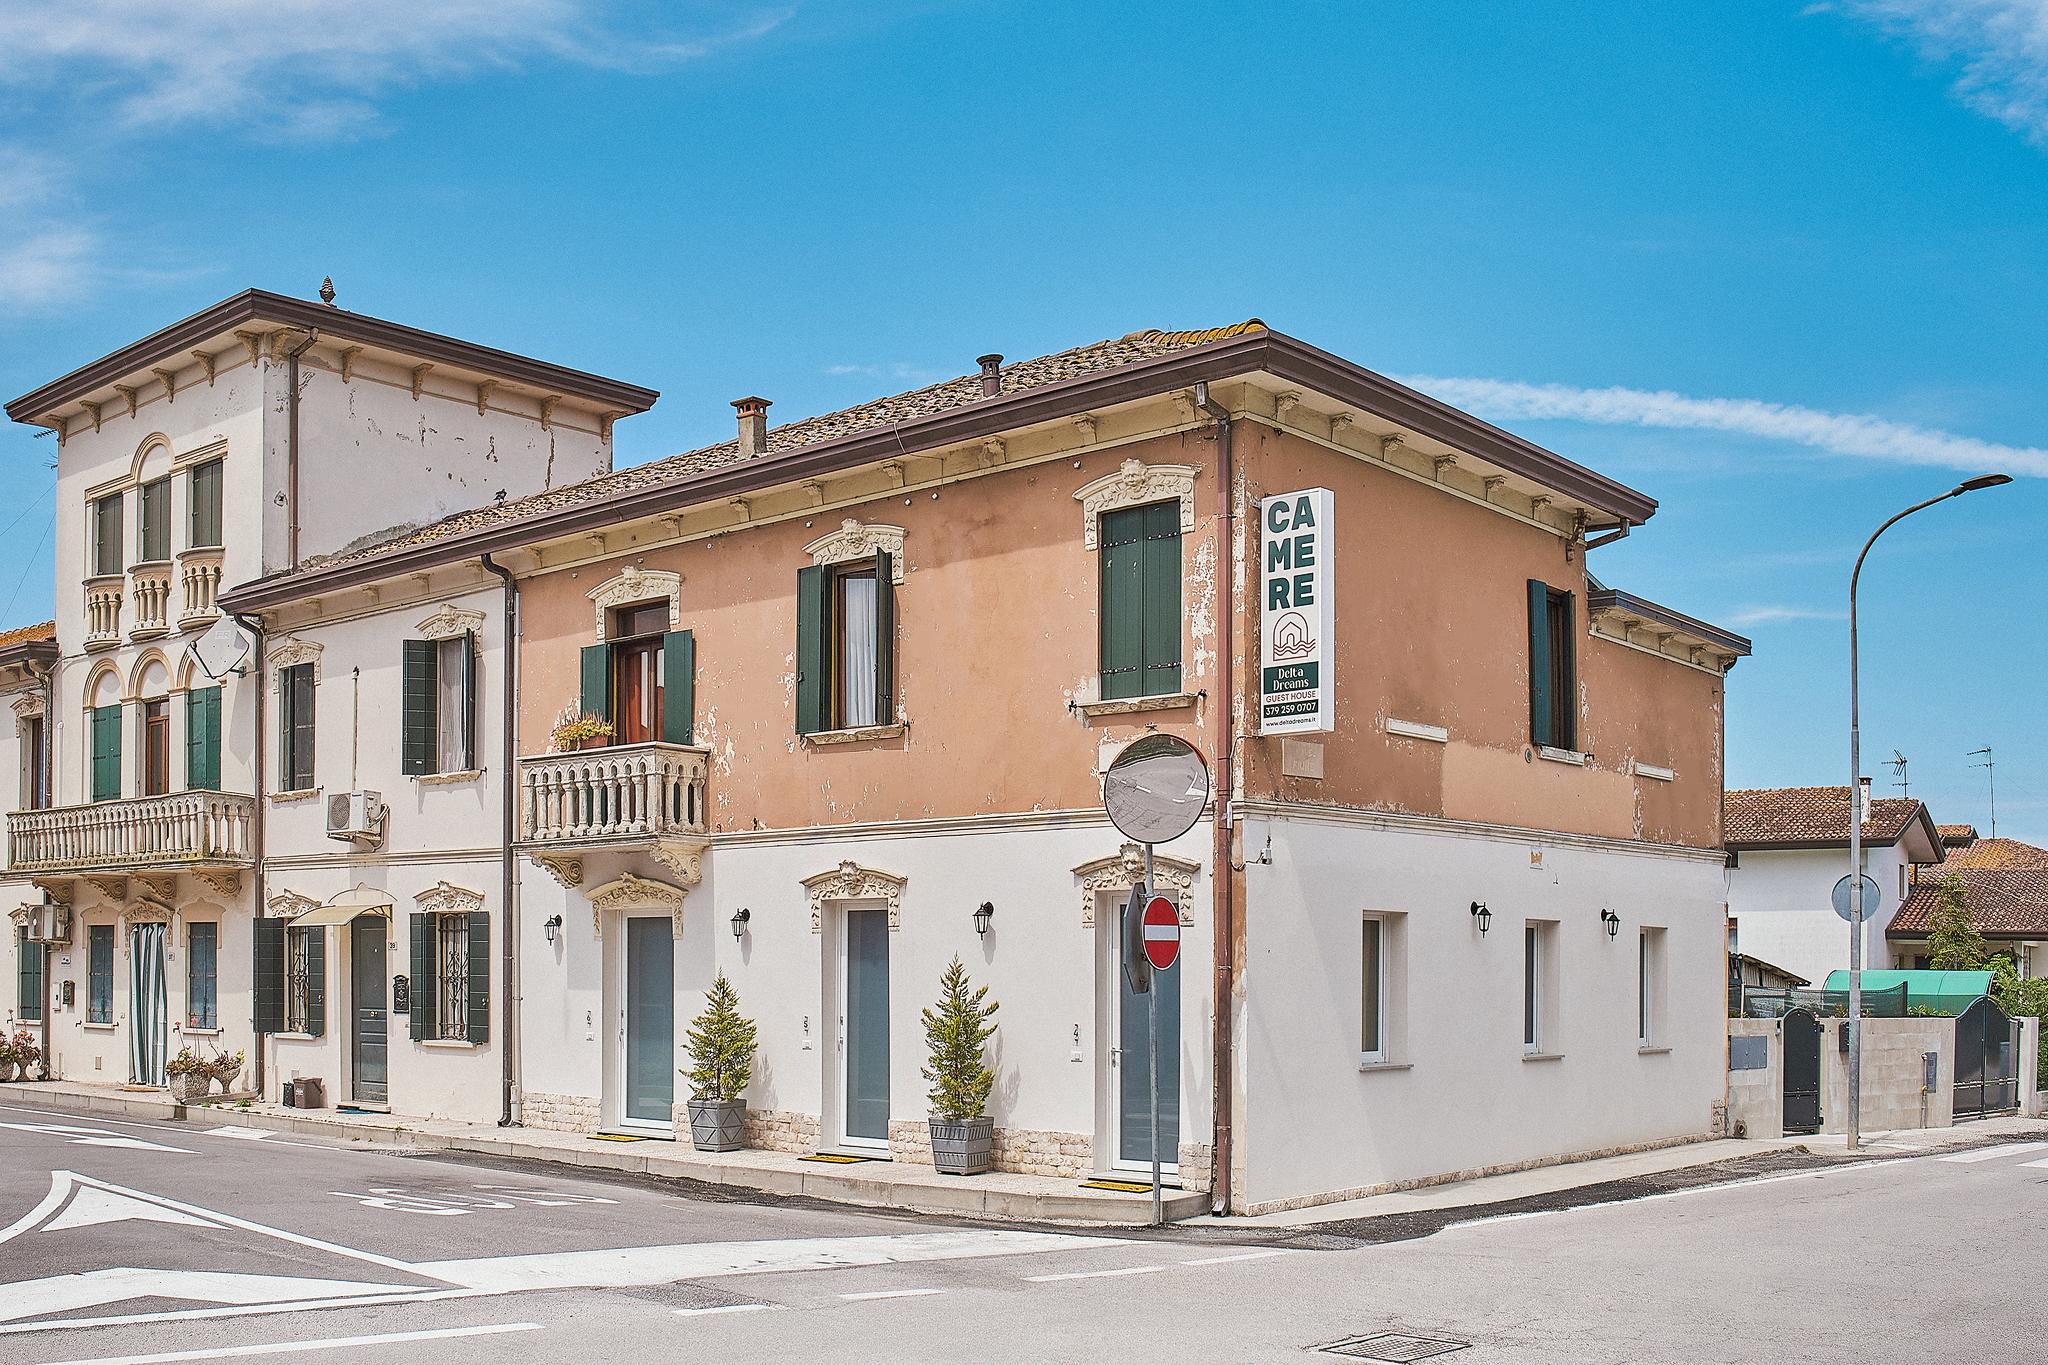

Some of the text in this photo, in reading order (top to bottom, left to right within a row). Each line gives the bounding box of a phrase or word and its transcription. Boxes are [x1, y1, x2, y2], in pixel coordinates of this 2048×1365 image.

[1268, 496, 1315, 533] CA
[1268, 534, 1315, 573] ME
[1268, 572, 1314, 611] RE
[1278, 667, 1304, 680] Delta
[1273, 679, 1309, 691] Dreams
[1266, 690, 1316, 703] GUEST HOUSE
[1265, 702, 1316, 716] 379 259 0707
[1266, 717, 1316, 727] www.deltadreams.it
